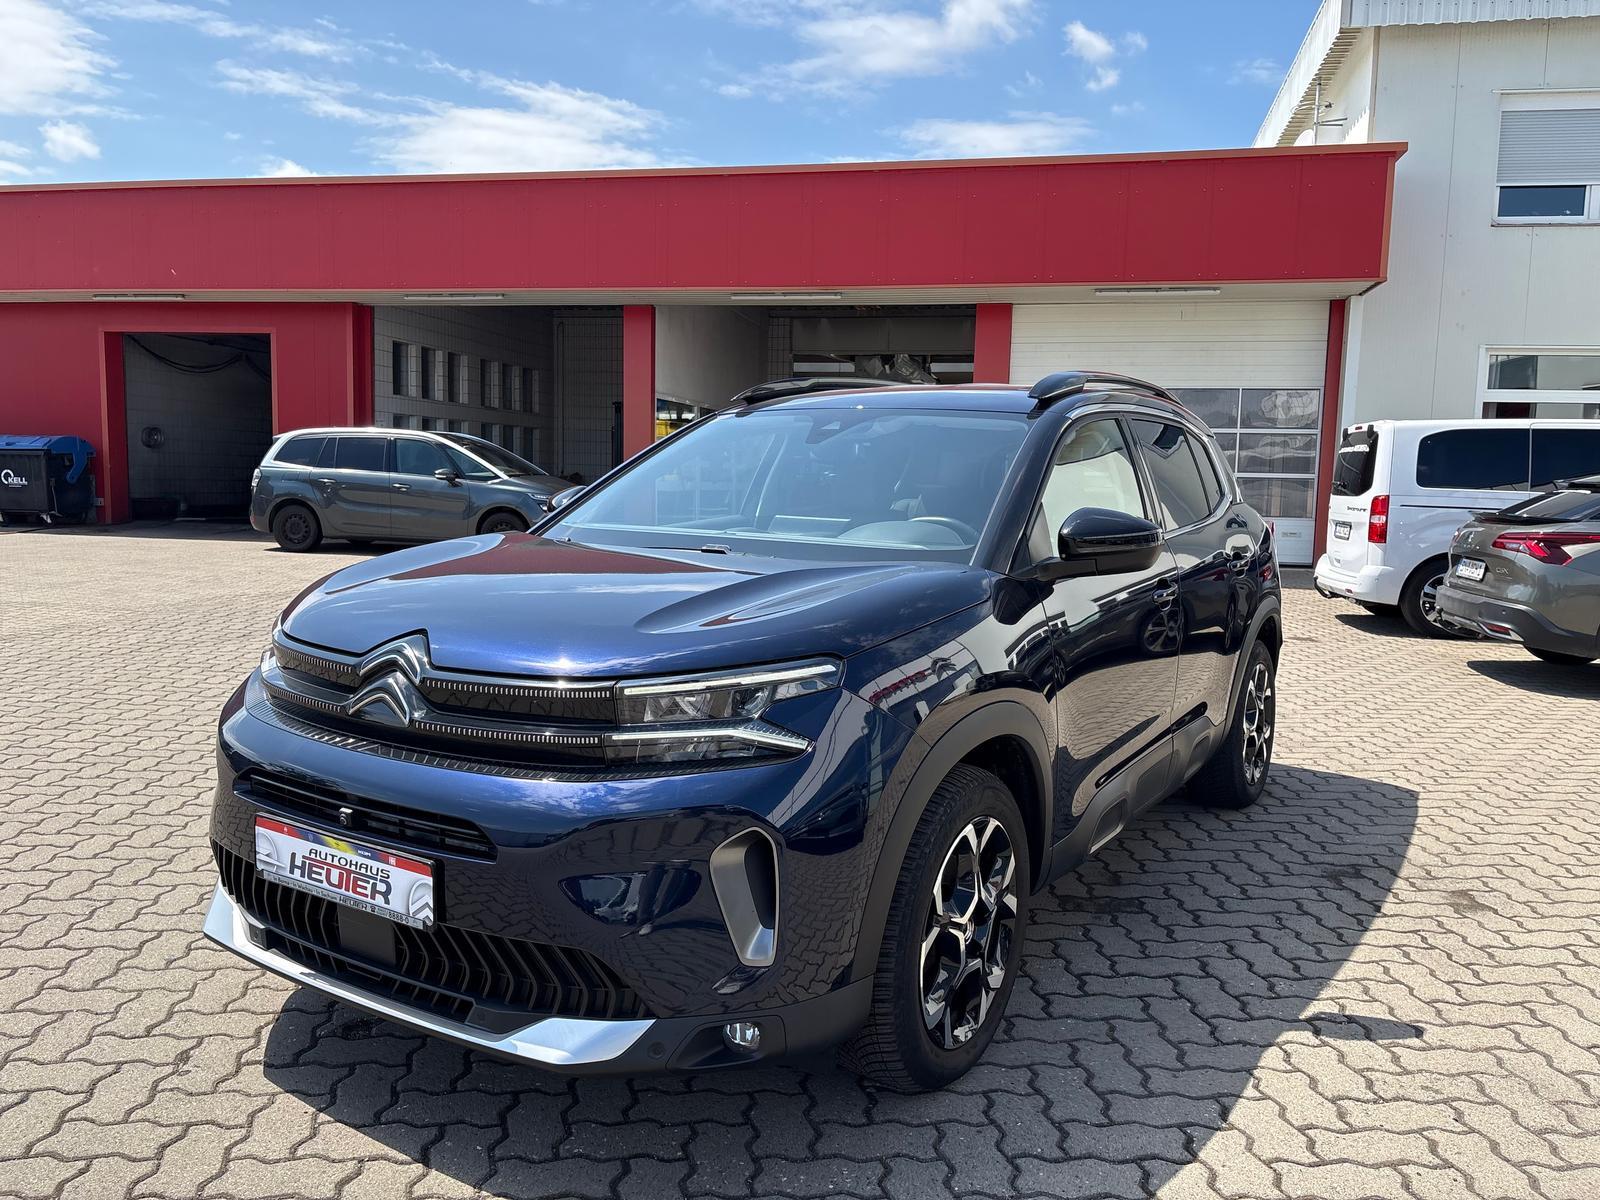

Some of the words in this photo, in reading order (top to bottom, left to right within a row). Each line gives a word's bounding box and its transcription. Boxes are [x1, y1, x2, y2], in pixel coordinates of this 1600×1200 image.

[8, 476, 28, 485] KELL
[288, 851, 393, 906] HEUTER
[309, 848, 391, 879] AUTOHAUS
